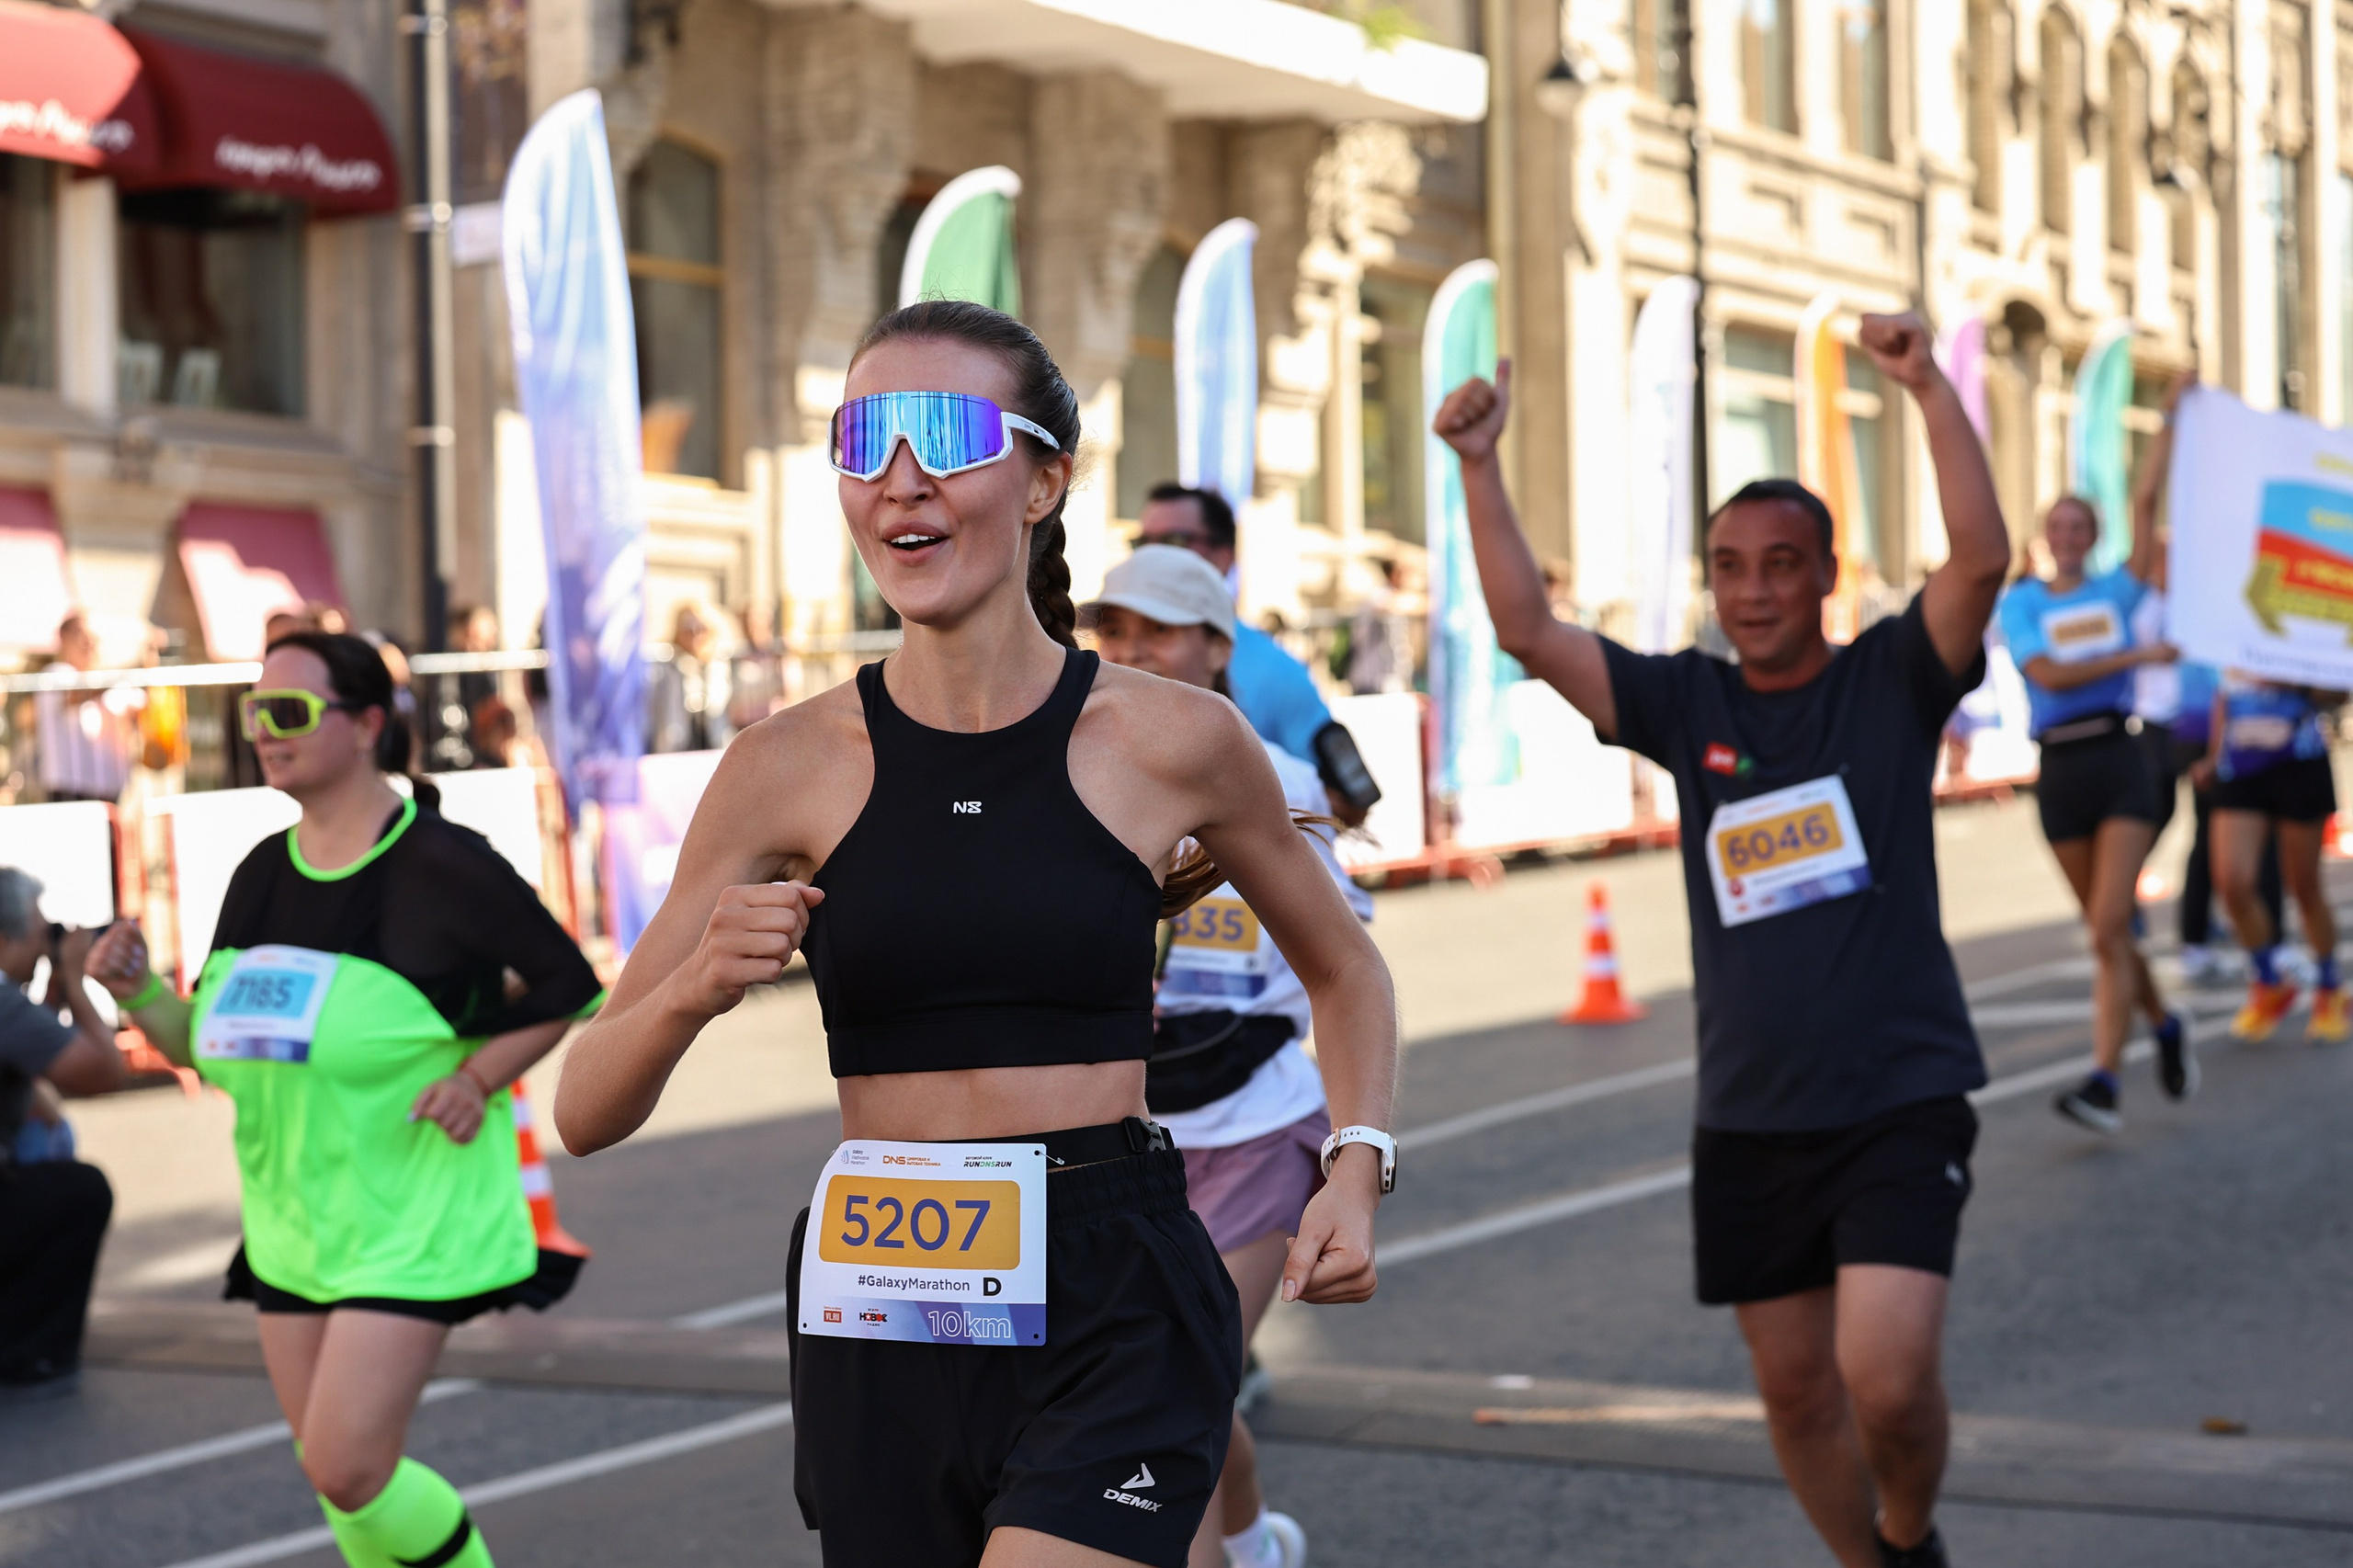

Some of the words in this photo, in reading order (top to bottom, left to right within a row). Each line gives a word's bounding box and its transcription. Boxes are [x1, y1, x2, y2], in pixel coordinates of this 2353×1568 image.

[1727, 814, 1829, 868] 6046
[228, 976, 293, 1009] 7185
[883, 1155, 905, 1165] DNS
[841, 1195, 991, 1252] 5207
[858, 1275, 971, 1291] #GalaxyMarathon
[983, 1277, 1002, 1296] D
[1103, 1488, 1163, 1512] DEMIX
